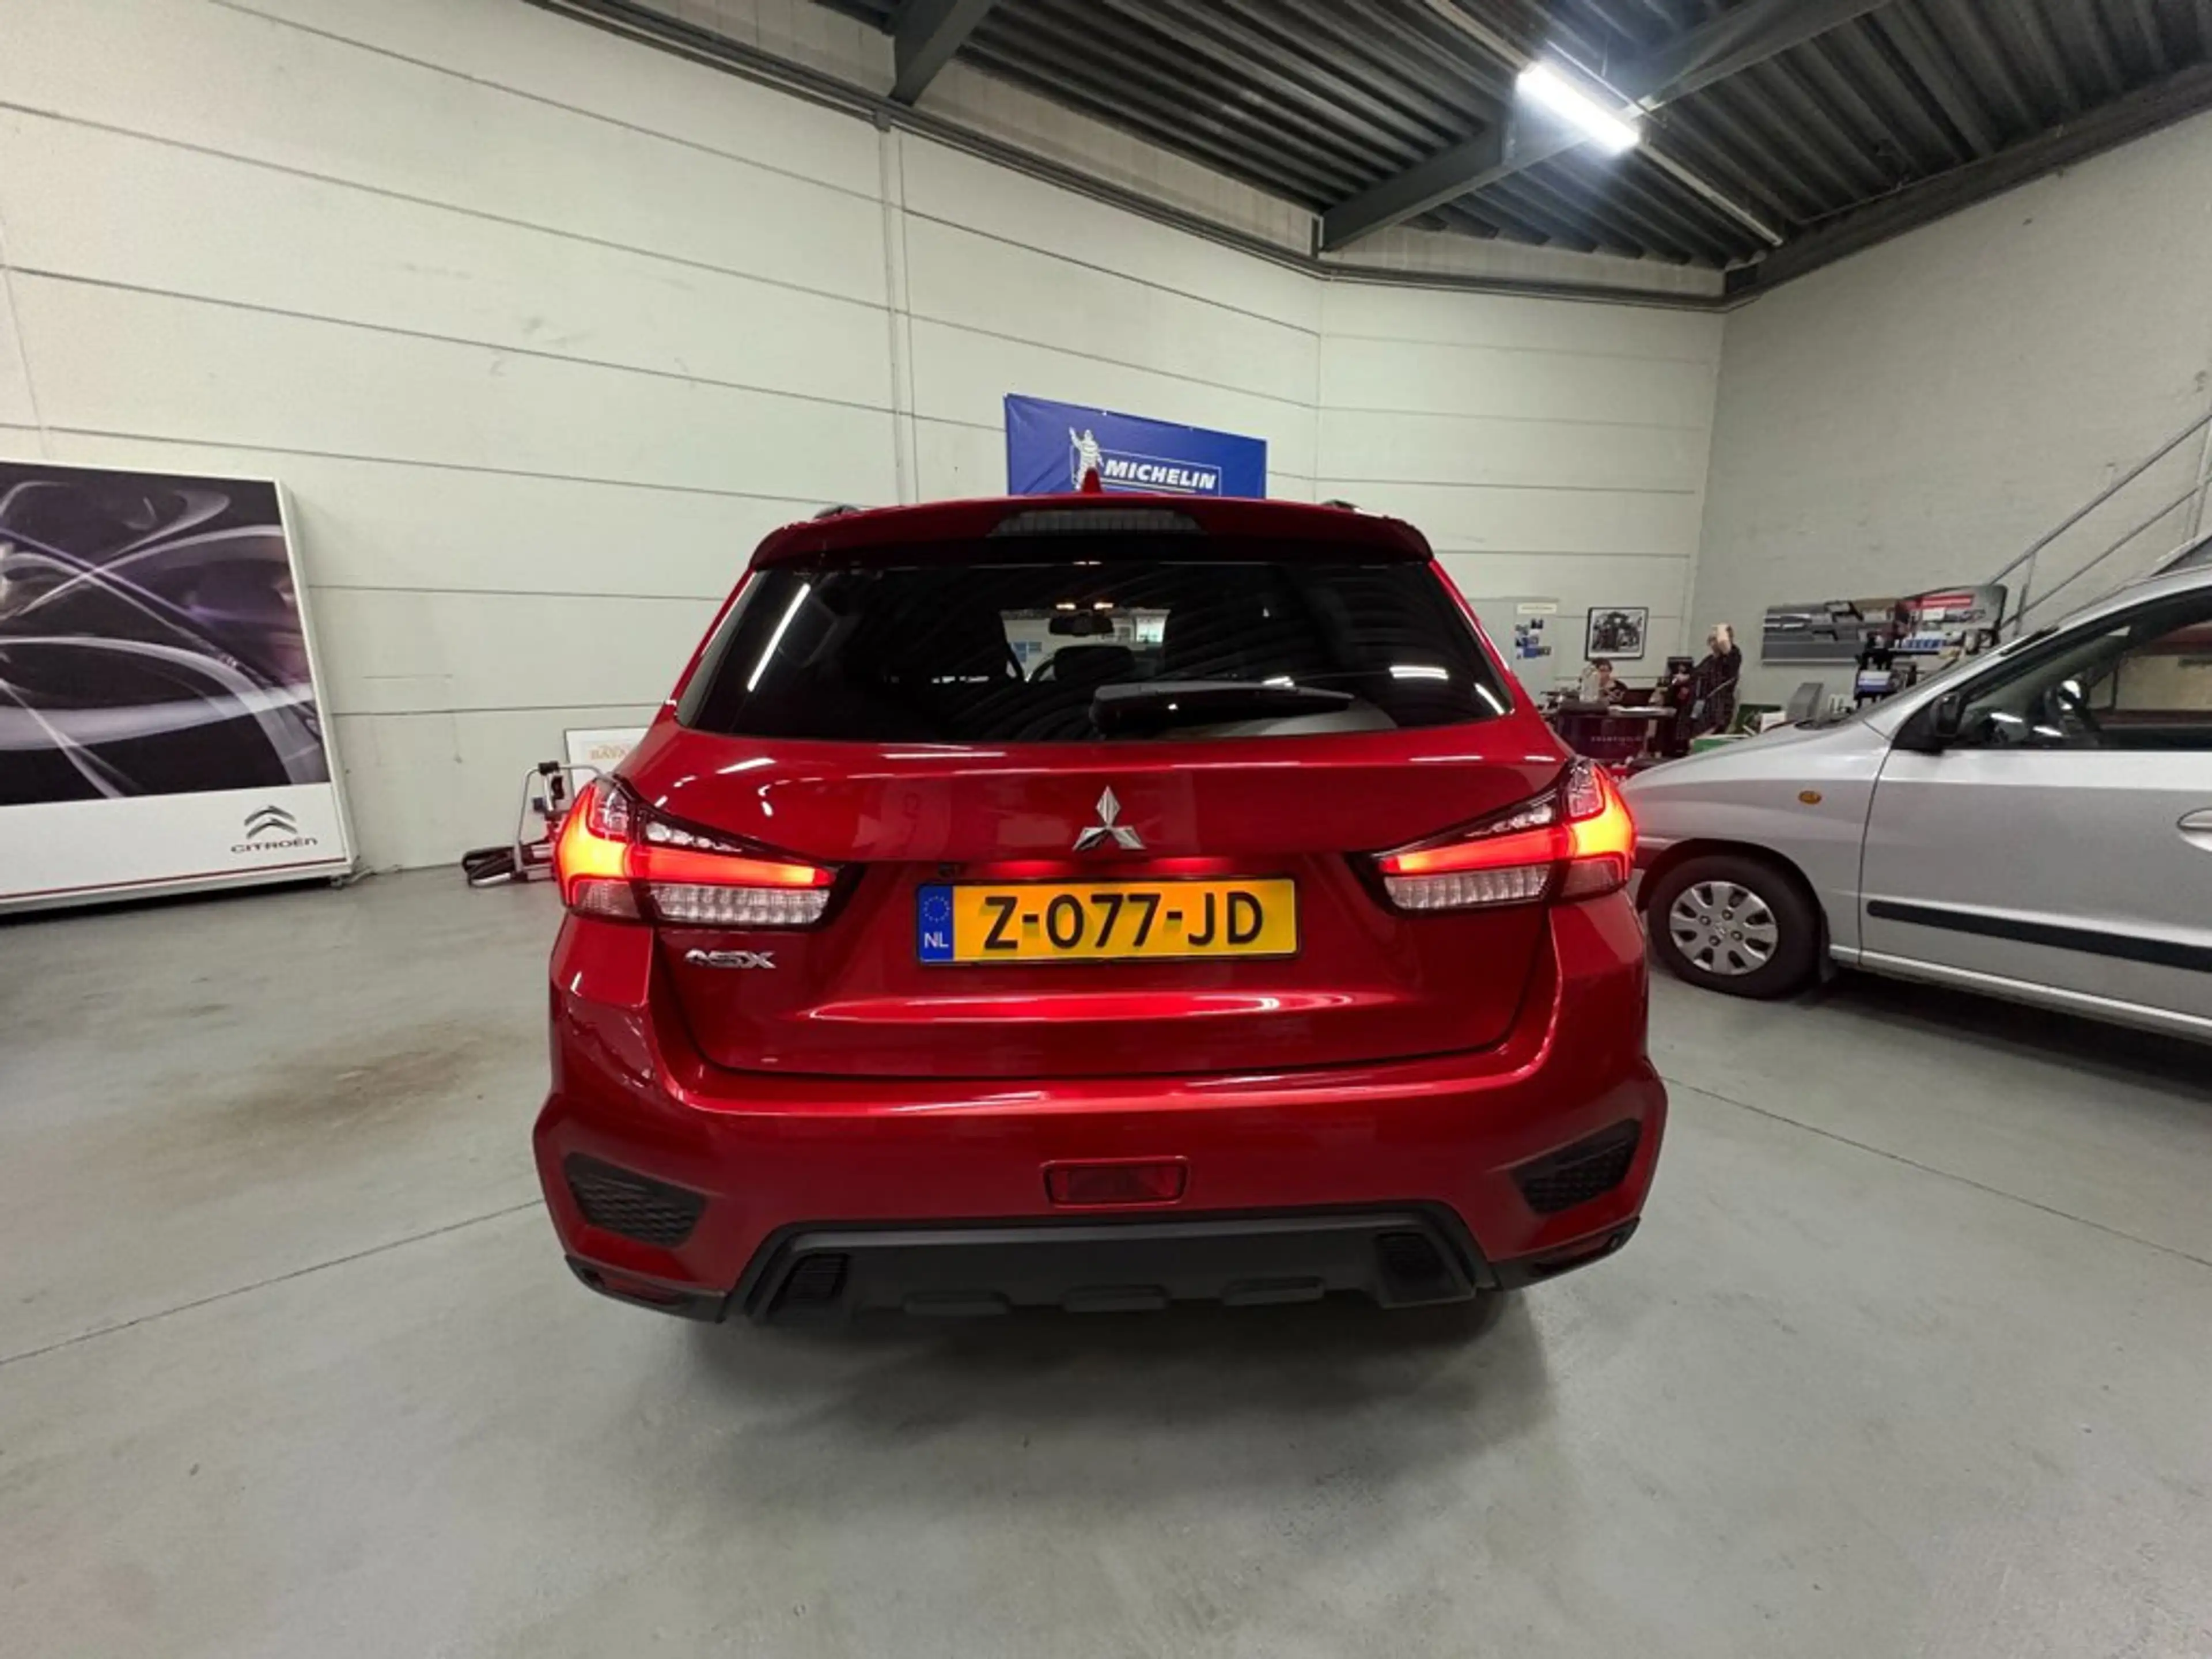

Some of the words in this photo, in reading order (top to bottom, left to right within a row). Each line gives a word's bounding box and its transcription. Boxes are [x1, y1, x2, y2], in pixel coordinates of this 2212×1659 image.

[1105, 459, 1217, 490] MICHELIN
[984, 891, 1263, 950] Z-077-JD
[923, 932, 949, 948] NL
[684, 948, 777, 969] ASX
